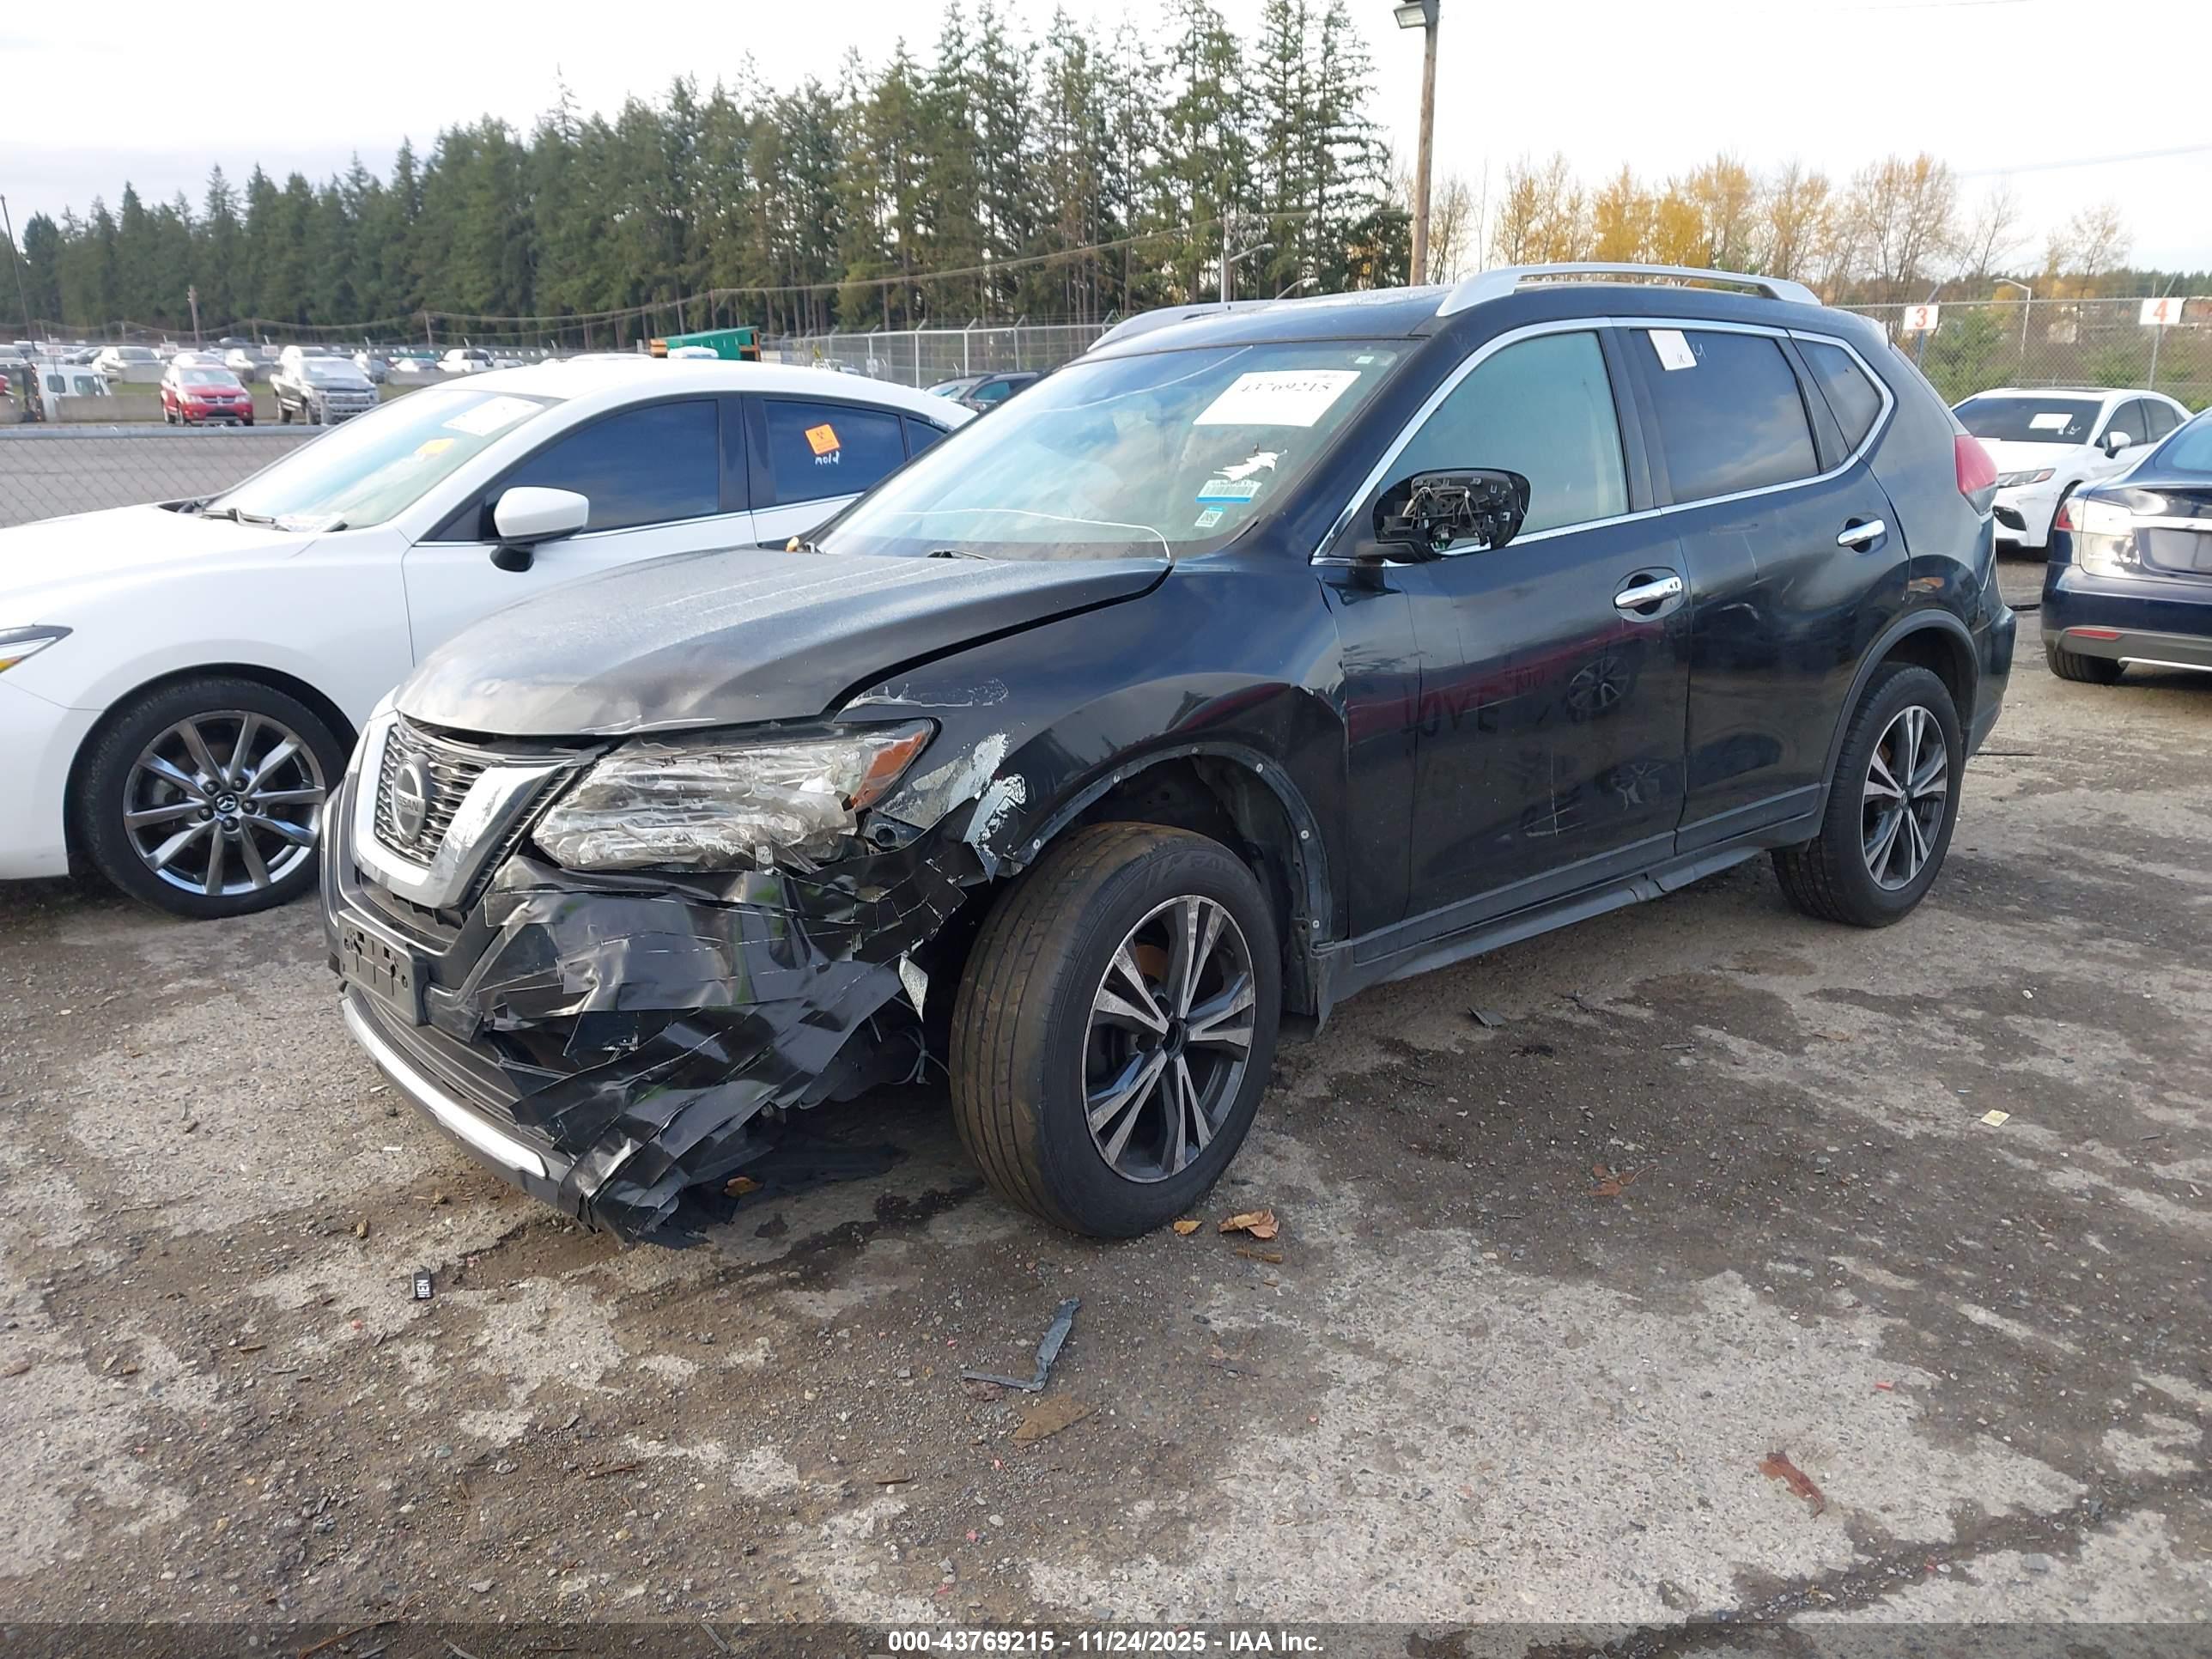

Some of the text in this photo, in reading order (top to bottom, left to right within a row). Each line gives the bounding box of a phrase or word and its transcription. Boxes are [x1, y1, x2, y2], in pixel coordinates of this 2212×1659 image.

[1914, 306, 1929, 328] 3
[2153, 299, 2169, 323] 4
[814, 450, 841, 465] mold
